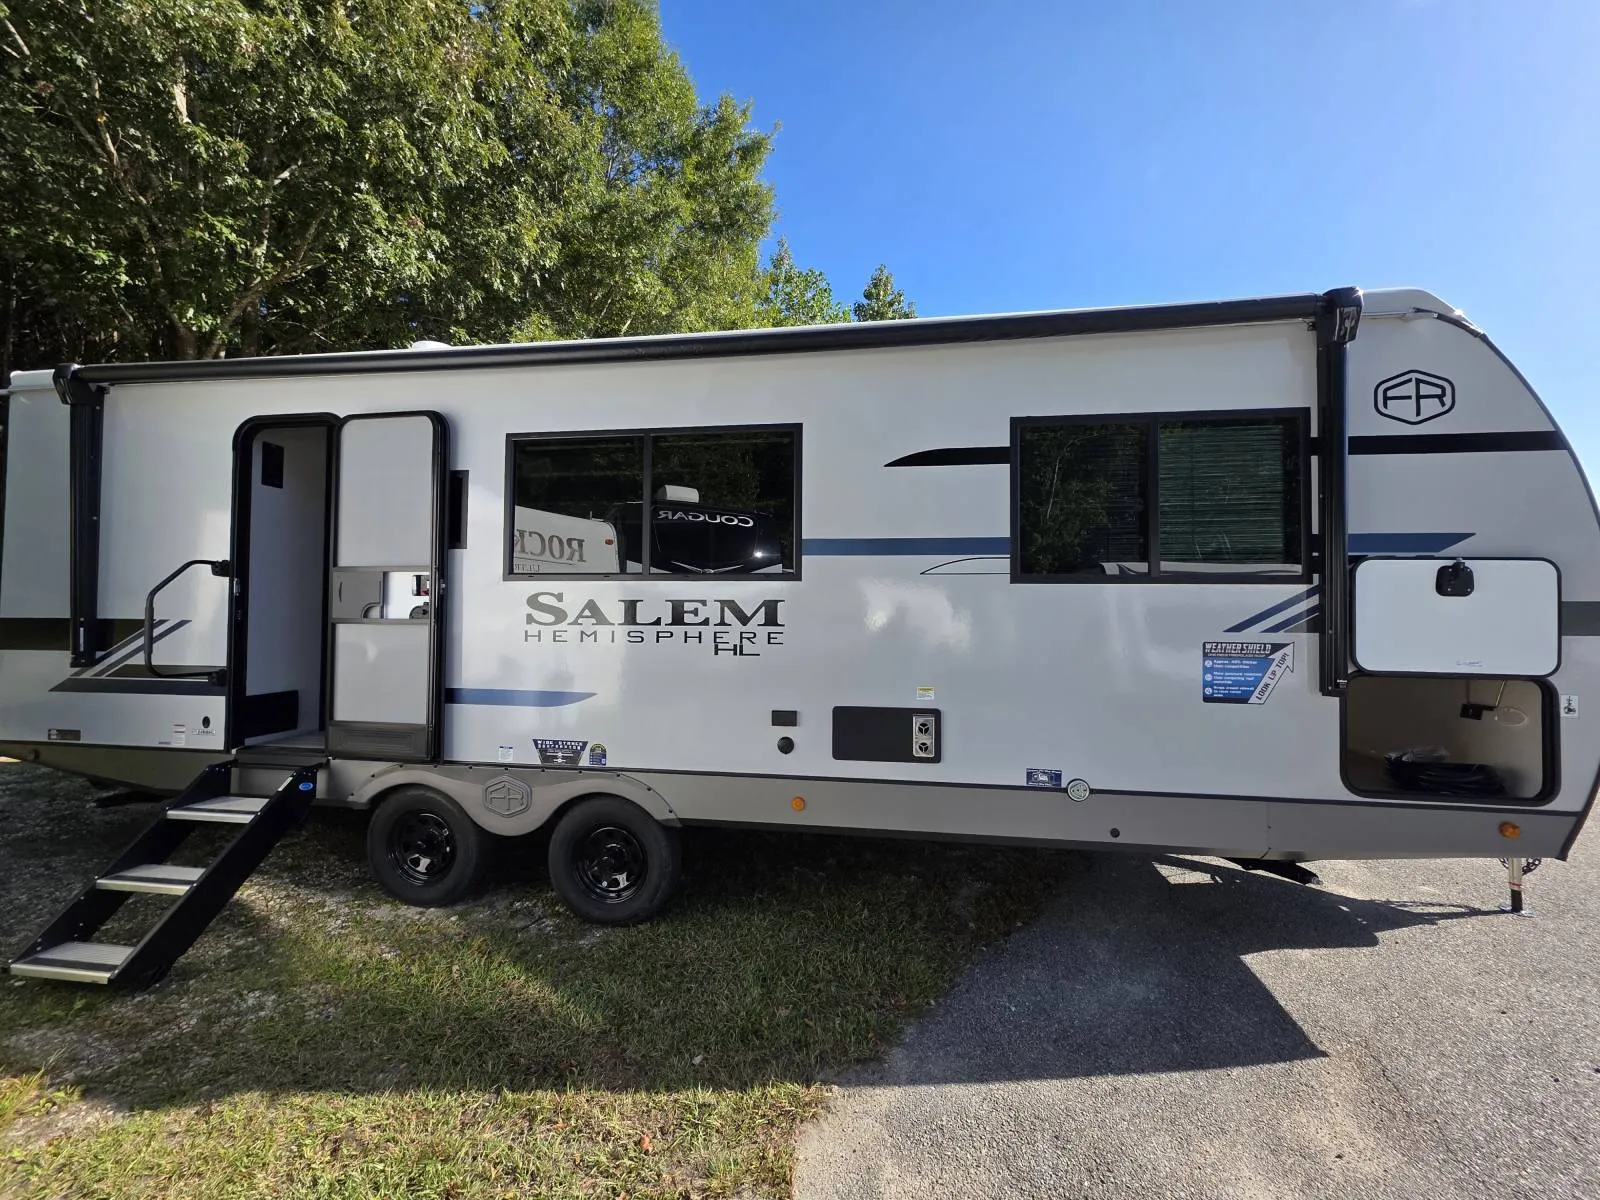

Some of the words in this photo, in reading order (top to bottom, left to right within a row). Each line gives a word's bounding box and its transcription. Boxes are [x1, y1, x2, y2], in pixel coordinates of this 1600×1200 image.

[1382, 377, 1447, 418] FR
[525, 591, 786, 627] SALEM
[524, 630, 785, 645] HEMISPHERE
[713, 644, 761, 656] HL
[1205, 643, 1242, 654] WEATHER
[1242, 644, 1272, 654] SHIELD
[1255, 681, 1271, 701] LOOK
[1268, 670, 1277, 680] UP
[1275, 652, 1290, 669] TOP!
